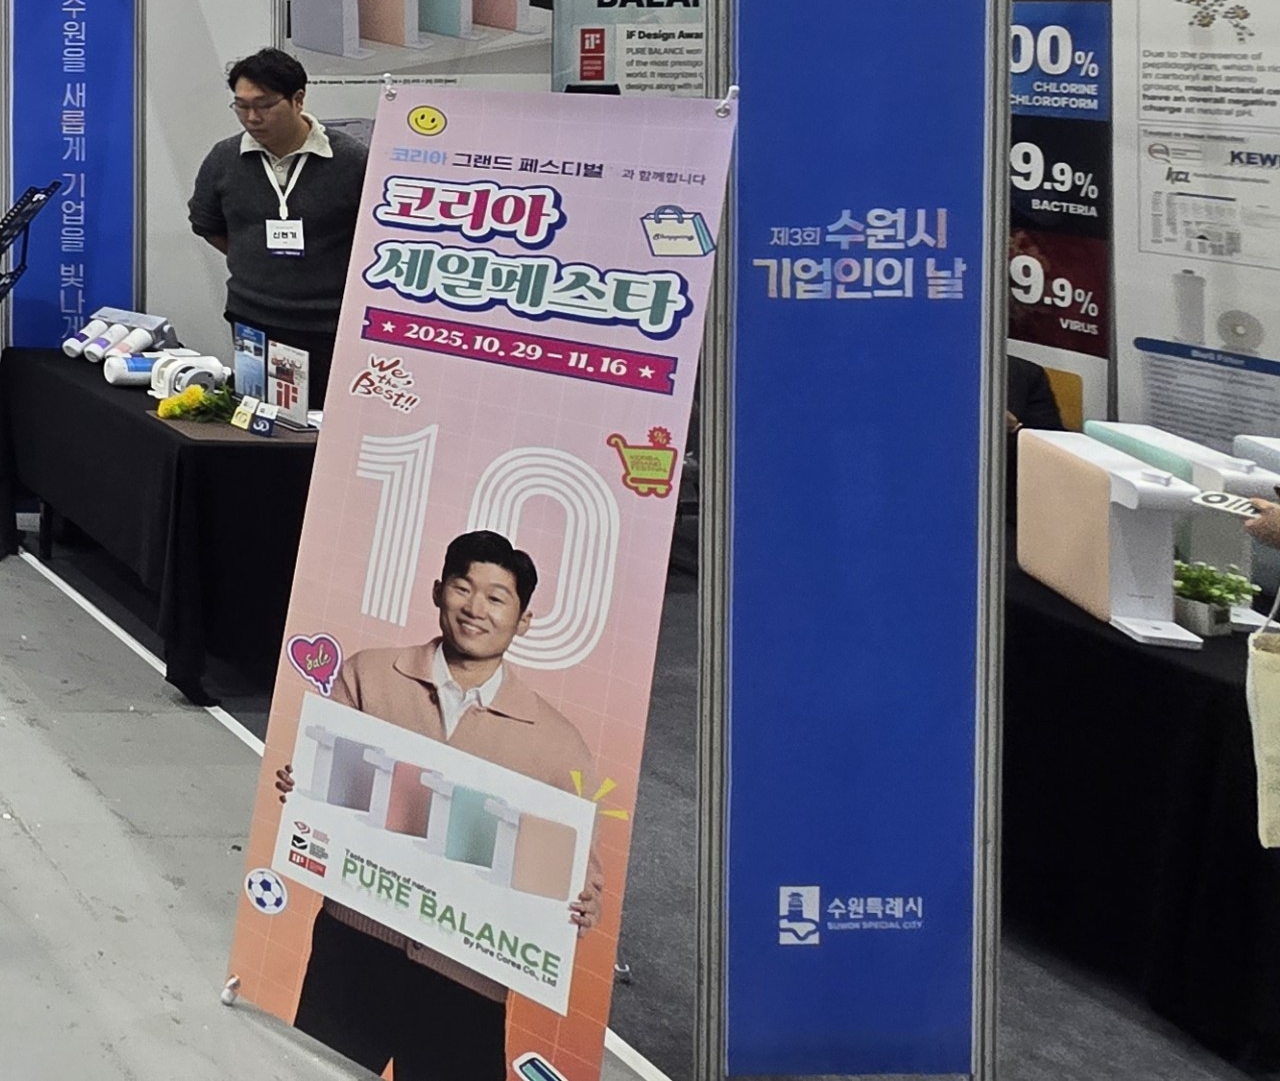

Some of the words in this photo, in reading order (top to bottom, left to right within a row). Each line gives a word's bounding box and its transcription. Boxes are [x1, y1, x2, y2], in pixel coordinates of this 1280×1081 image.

[638, 30, 676, 41] Design
[1033, 81, 1098, 96] CHLORINE
[62, 82, 87, 163] 새롭게
[391, 147, 447, 166] 코리아
[452, 152, 513, 171] 그랜드
[622, 168, 635, 181] 과
[639, 170, 706, 186] 함께합니다
[1231, 150, 1280, 167] KEW
[60, 171, 87, 253] 기업을
[383, 182, 552, 238] 코리아
[770, 227, 821, 247] 제3회
[826, 207, 948, 250] 수원시
[1031, 198, 1098, 217] BACTERIA
[371, 247, 679, 327] 세일페스타
[752, 257, 914, 300] 기업인의
[926, 257, 967, 300] 날
[1059, 317, 1099, 335] VIRUS
[377, 374, 398, 389] the
[356, 424, 620, 670] 10
[344, 849, 365, 865] Taste
[366, 856, 378, 870] the
[379, 863, 401, 884] purity
[403, 873, 412, 885] of
[412, 879, 437, 897] nature
[342, 858, 412, 908] PURE
[420, 893, 561, 979] BALANCE
[827, 896, 923, 919] 수원특례시
[827, 922, 860, 930] SUWON
[862, 921, 900, 929] SPECIAL
[464, 936, 474, 949] By
[475, 942, 495, 957] Pure
[542, 973, 557, 987] Ltd
